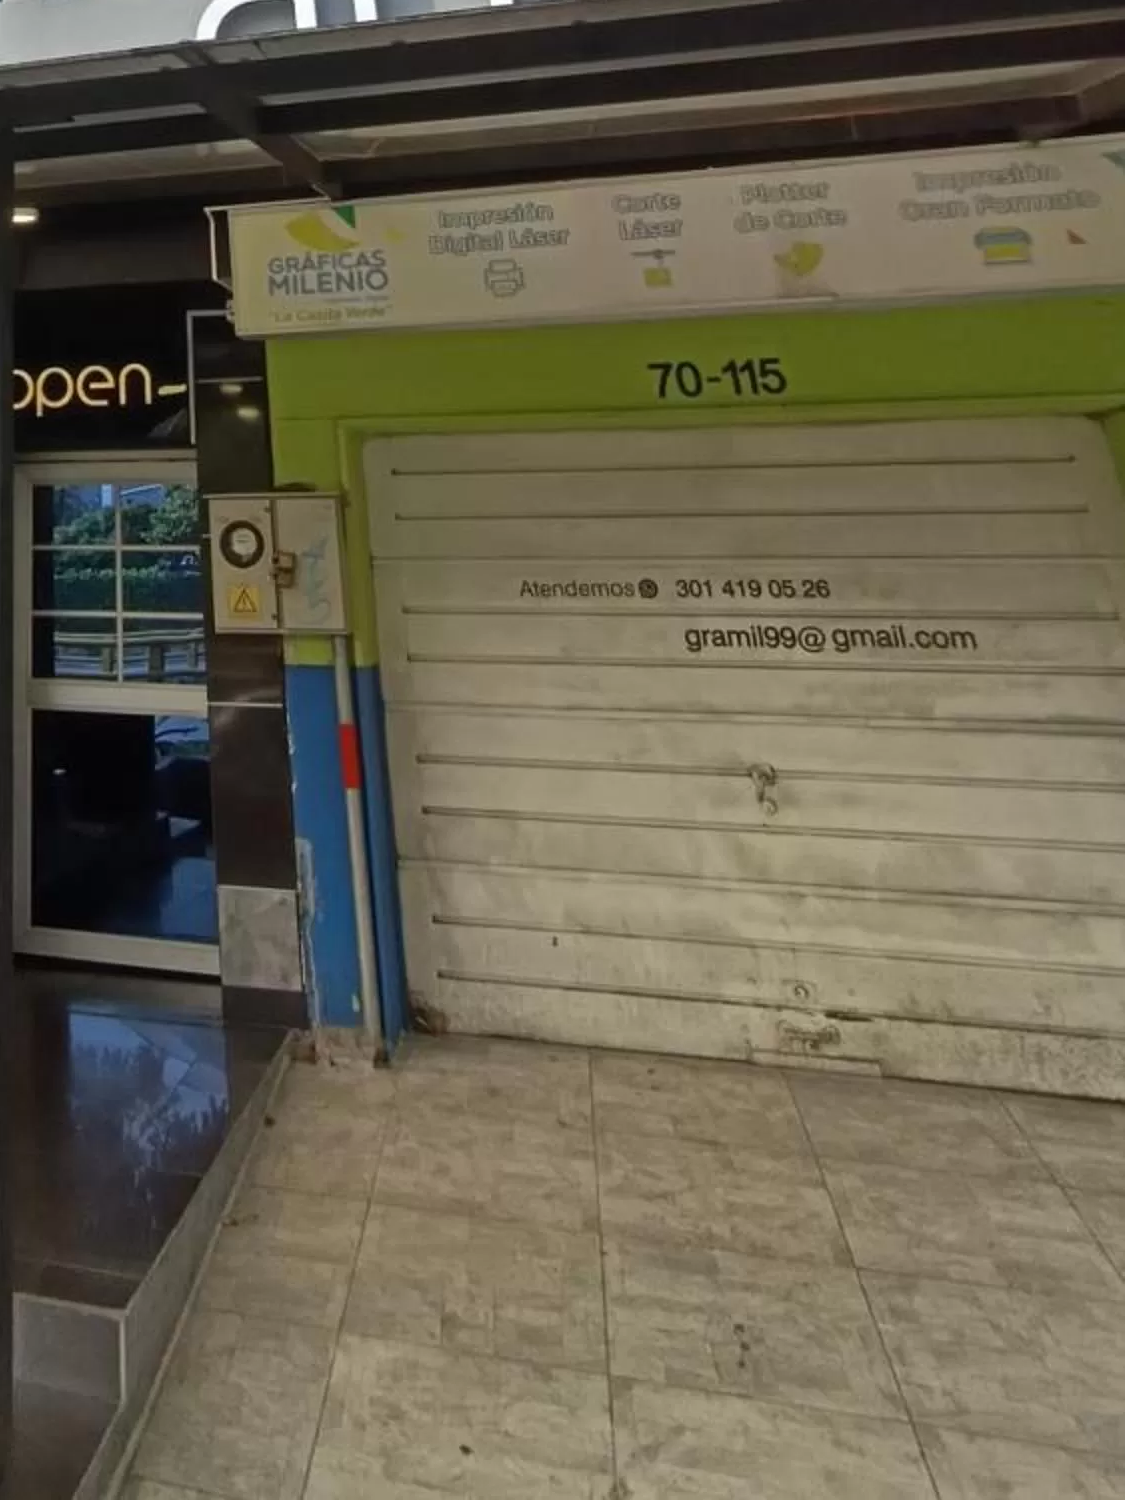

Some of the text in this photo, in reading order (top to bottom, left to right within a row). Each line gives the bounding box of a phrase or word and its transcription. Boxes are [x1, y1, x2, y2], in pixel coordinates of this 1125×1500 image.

[268, 268, 388, 296] MILENIO
[648, 357, 787, 398] 70-115
[520, 579, 831, 598] Atendemos 301 419 05 26
